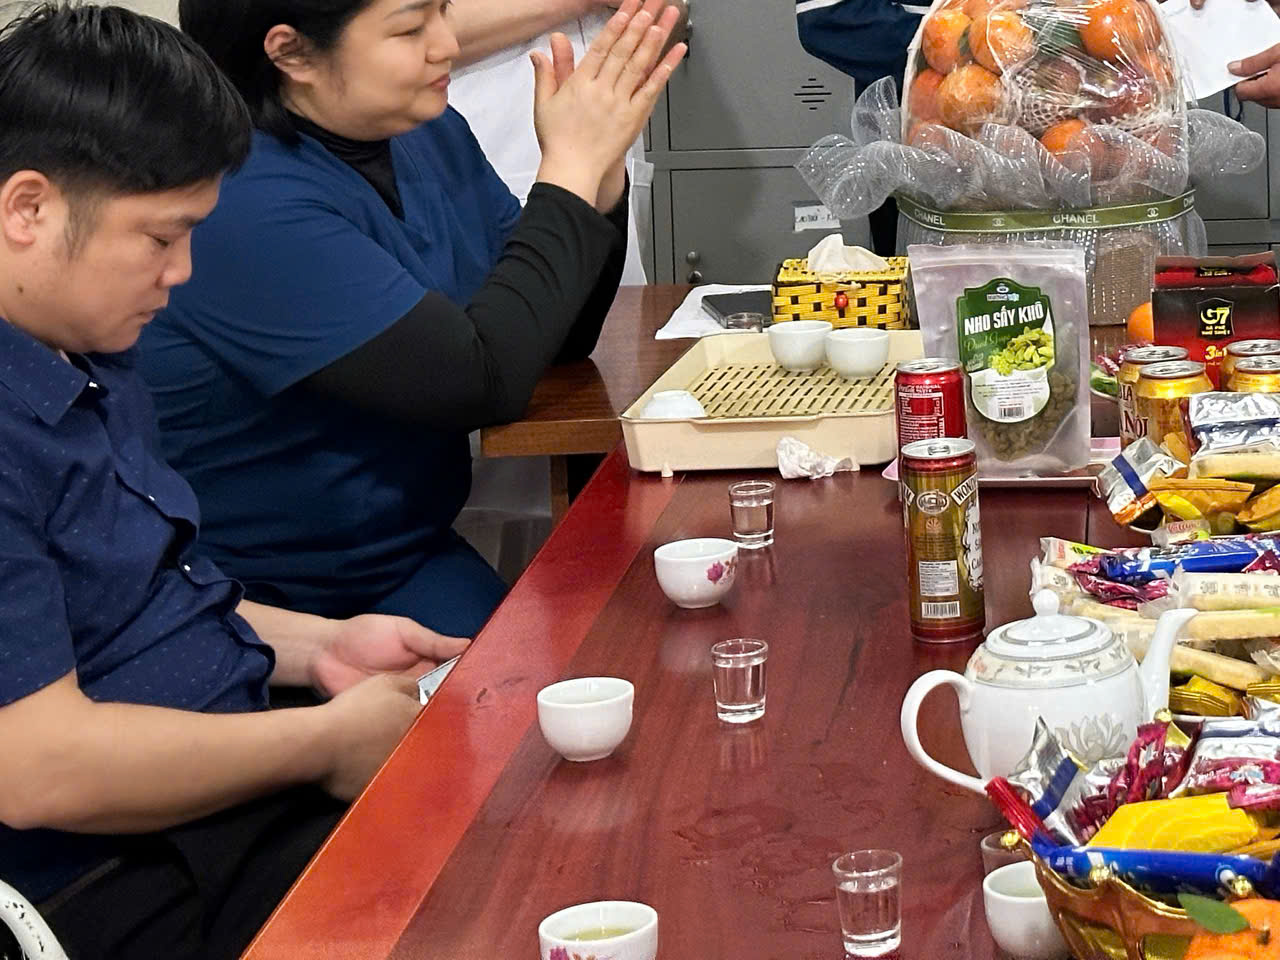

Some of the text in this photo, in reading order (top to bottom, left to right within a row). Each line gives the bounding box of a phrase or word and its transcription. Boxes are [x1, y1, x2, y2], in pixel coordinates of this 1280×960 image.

[914, 208, 946, 226] CHANEL
[1052, 213, 1099, 225] CHANEL
[964, 301, 1044, 336] NHO SẤY KHÔ
[1200, 306, 1231, 325] G7
